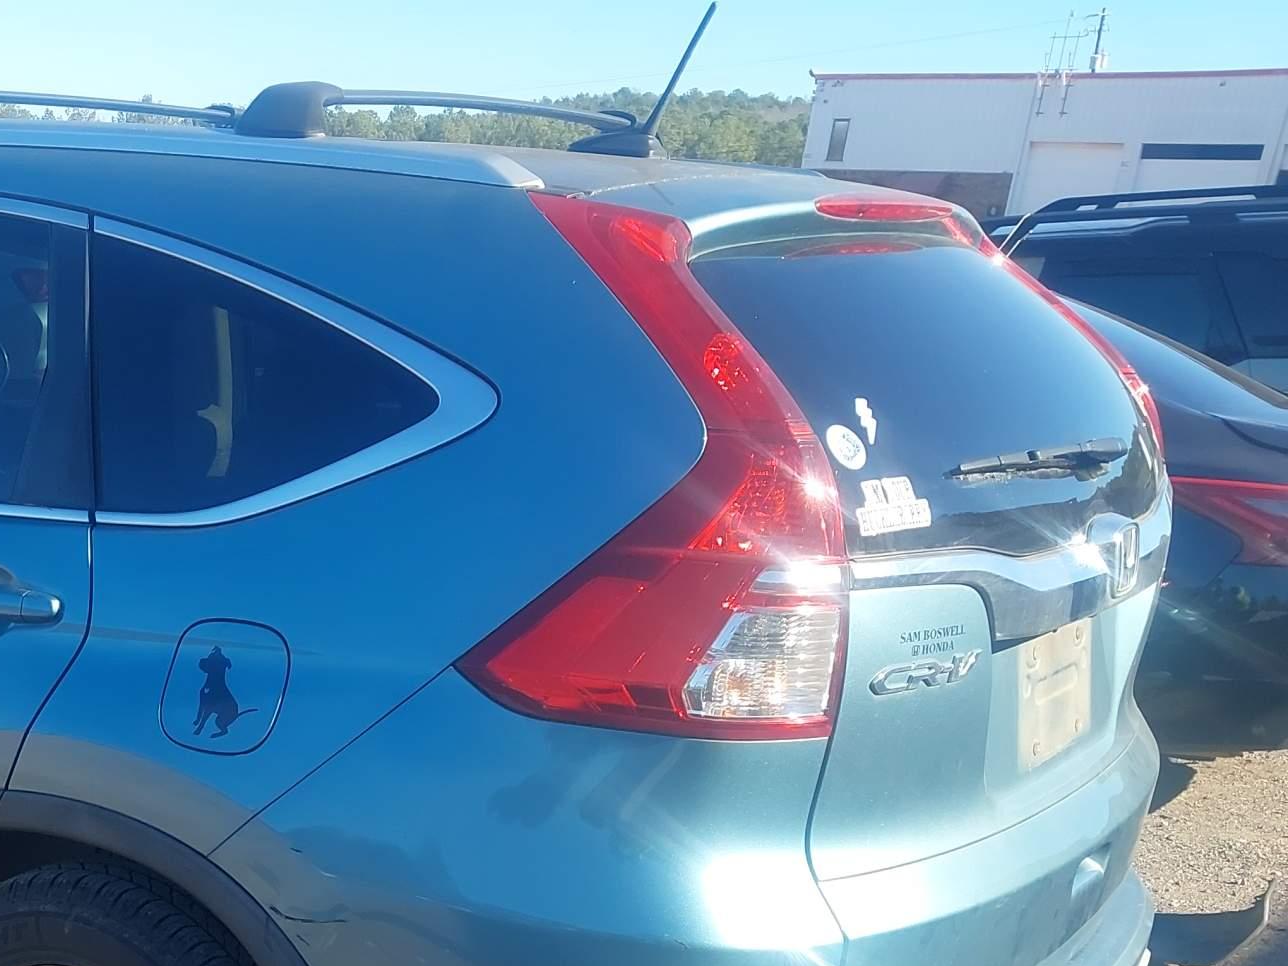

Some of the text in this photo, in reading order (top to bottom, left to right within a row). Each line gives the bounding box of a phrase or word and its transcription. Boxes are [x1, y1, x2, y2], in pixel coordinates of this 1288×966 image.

[900, 624, 966, 644] SAM BOSWELL
[922, 640, 955, 656] HONDA
[869, 648, 984, 696] CR-V
